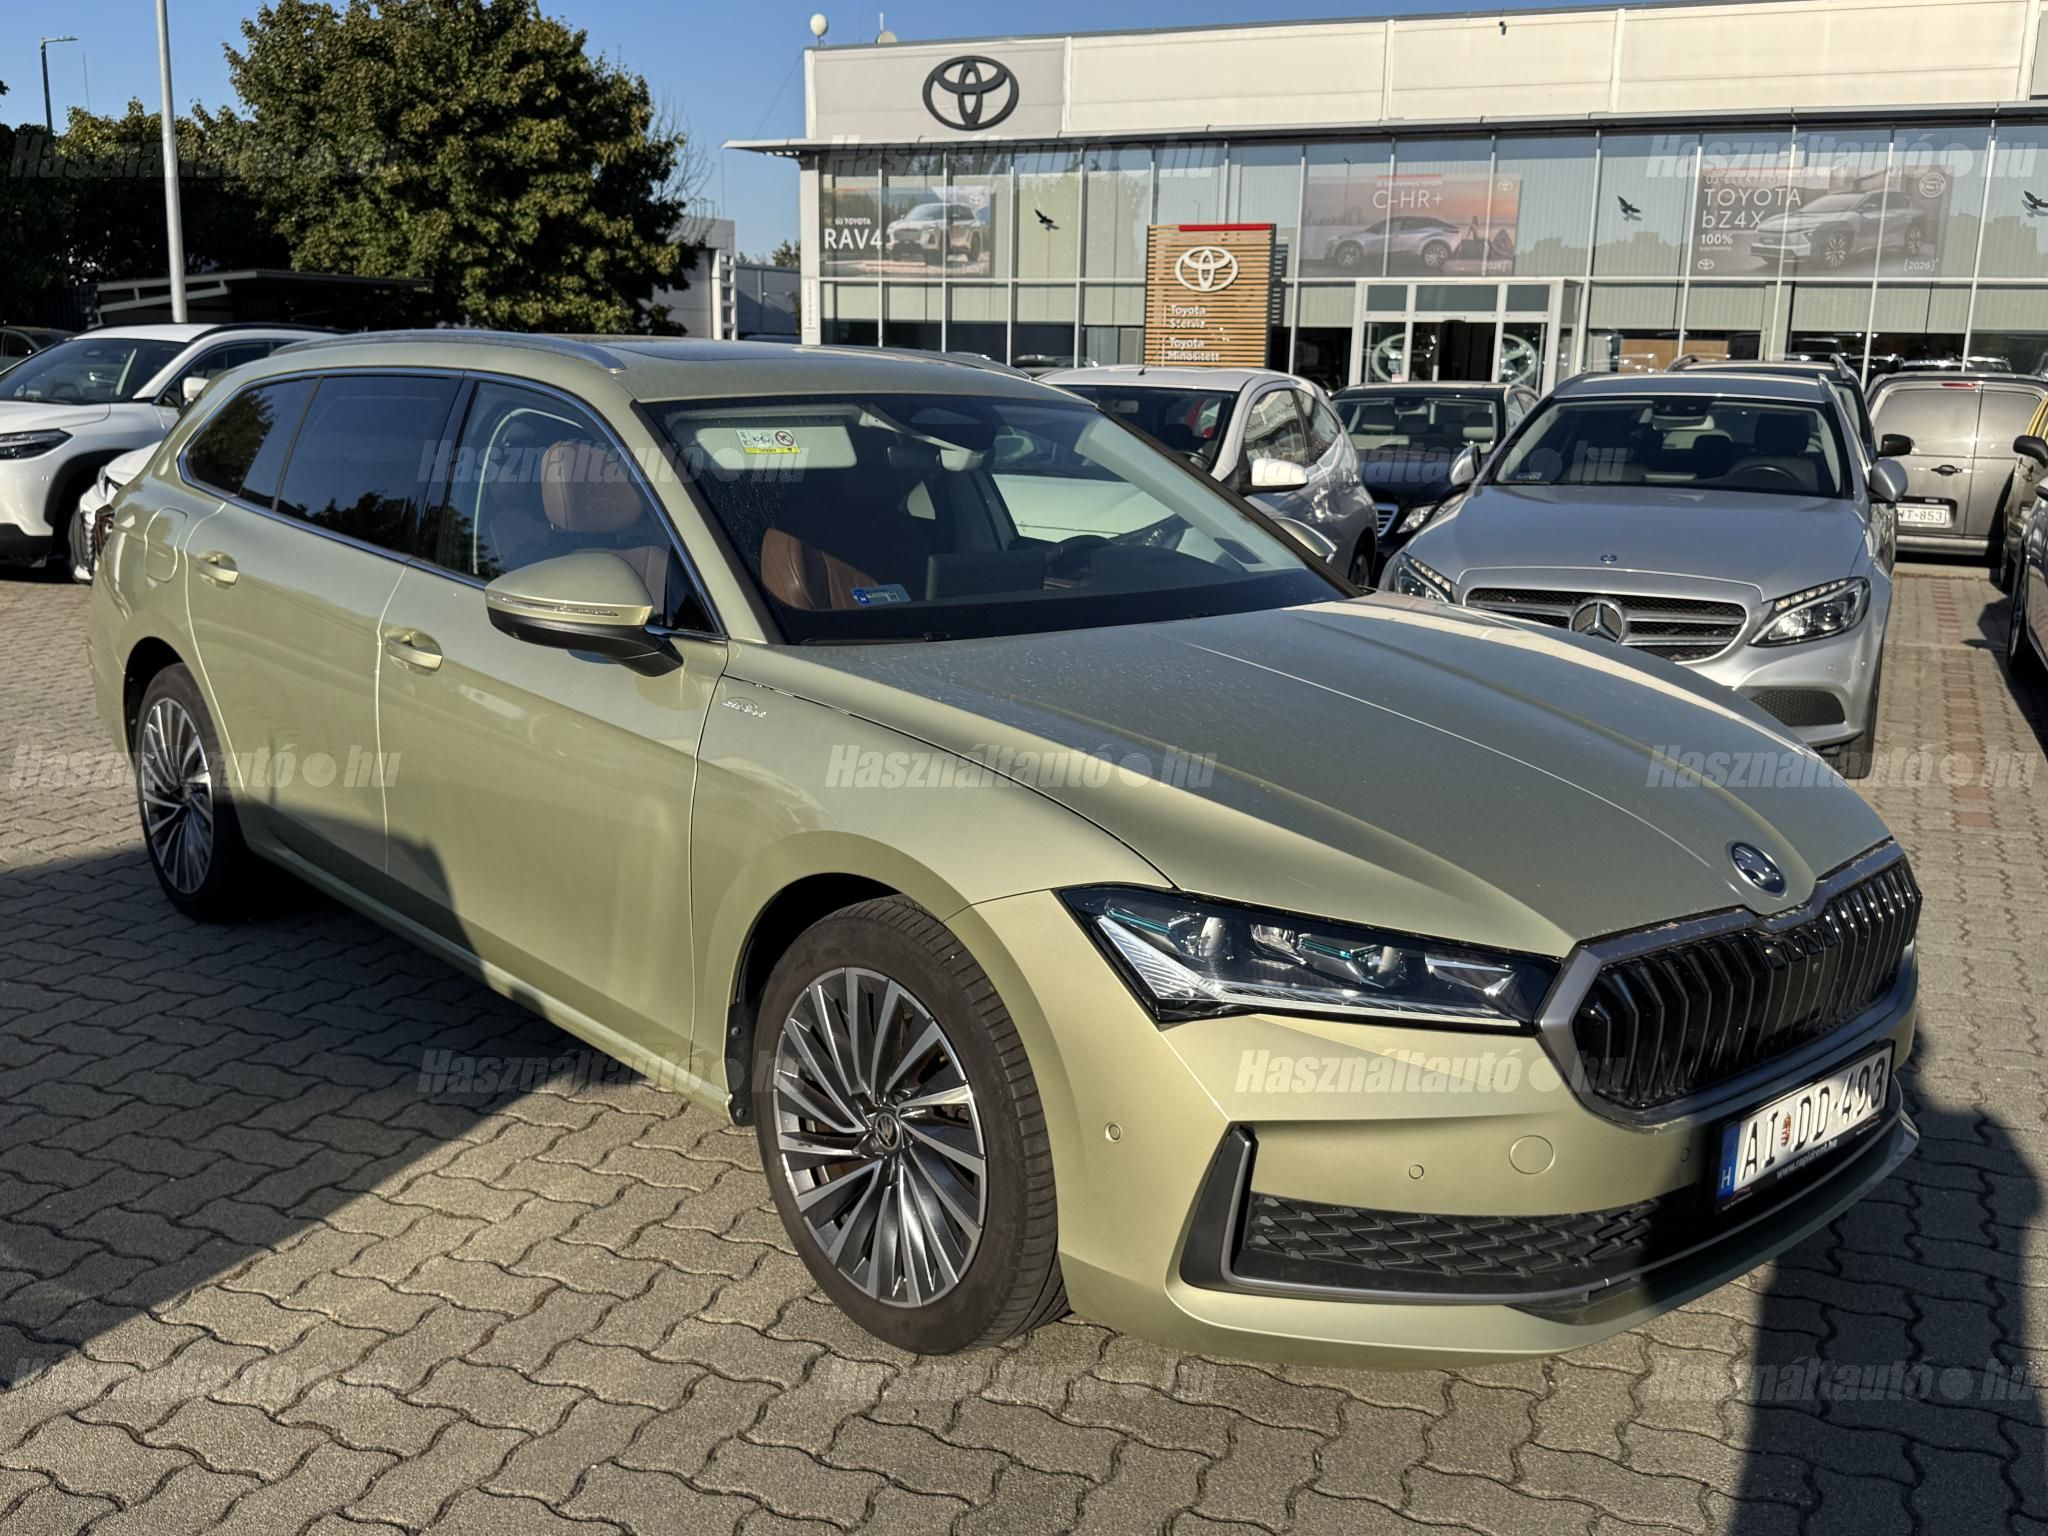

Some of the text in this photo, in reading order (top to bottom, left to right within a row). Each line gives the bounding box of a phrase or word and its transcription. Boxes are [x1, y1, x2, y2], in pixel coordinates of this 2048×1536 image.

[1704, 188, 1801, 206] TOYOTA
[1702, 210, 1765, 228] bZ4X
[824, 228, 882, 249] RAV4
[1701, 233, 1733, 244] 100%
[1170, 305, 1206, 317] Toyota
[1168, 337, 1205, 350] Toyota
[1739, 1109, 1779, 1181] AI
